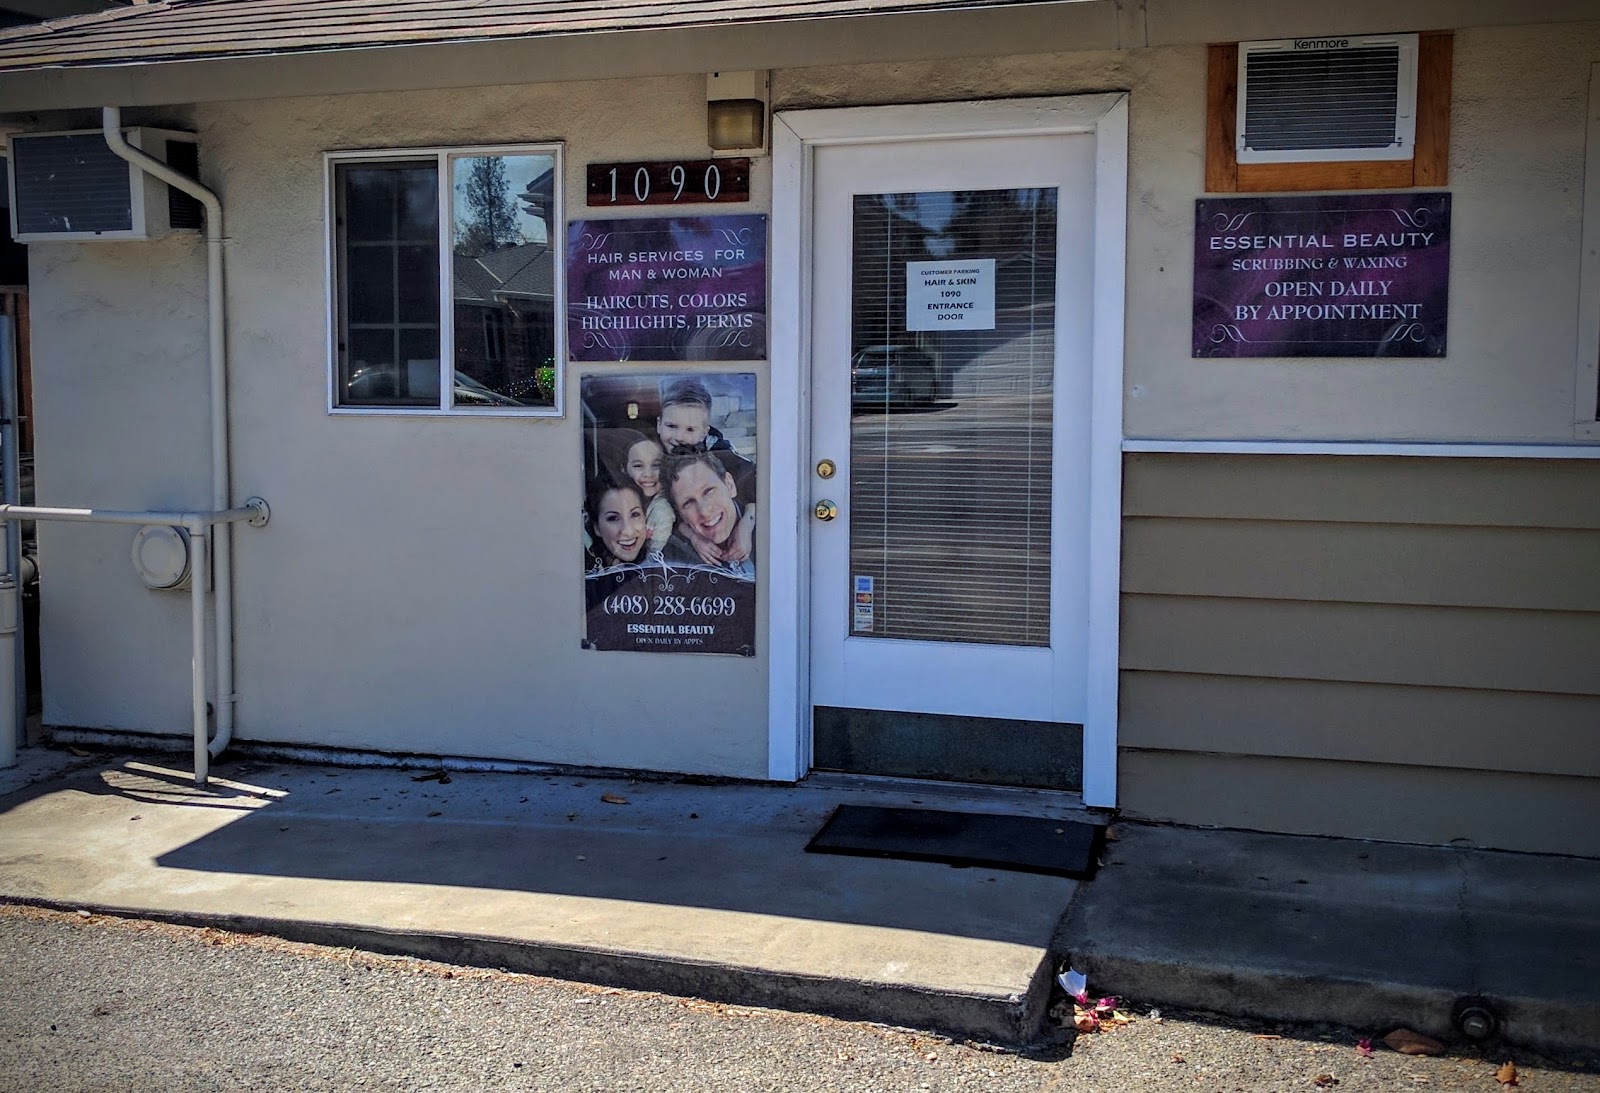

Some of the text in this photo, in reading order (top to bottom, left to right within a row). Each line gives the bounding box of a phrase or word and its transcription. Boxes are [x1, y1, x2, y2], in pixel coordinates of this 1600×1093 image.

[1294, 39, 1349, 49] Kenmore
[609, 165, 721, 202] 1090
[1210, 232, 1434, 250] ESSENTIAL BEAUTY
[587, 249, 746, 263] HAIR SERVICES FOR
[1232, 256, 1408, 271] SCRUBBING & WAXING
[609, 267, 722, 280] MAN & WOMAN
[940, 290, 961, 298] 1090
[1264, 280, 1393, 297] OPEN DAILY
[586, 292, 748, 310] HAIRCUTS, COLORS
[927, 302, 974, 310] ENTRANCE
[1234, 303, 1423, 321] BY APPOINTMENT
[581, 313, 753, 331] HIGHLIGHTS, PERMS
[603, 594, 736, 617] (408) 288-6699
[626, 623, 716, 635] ESSENTIAL BEAUTY
